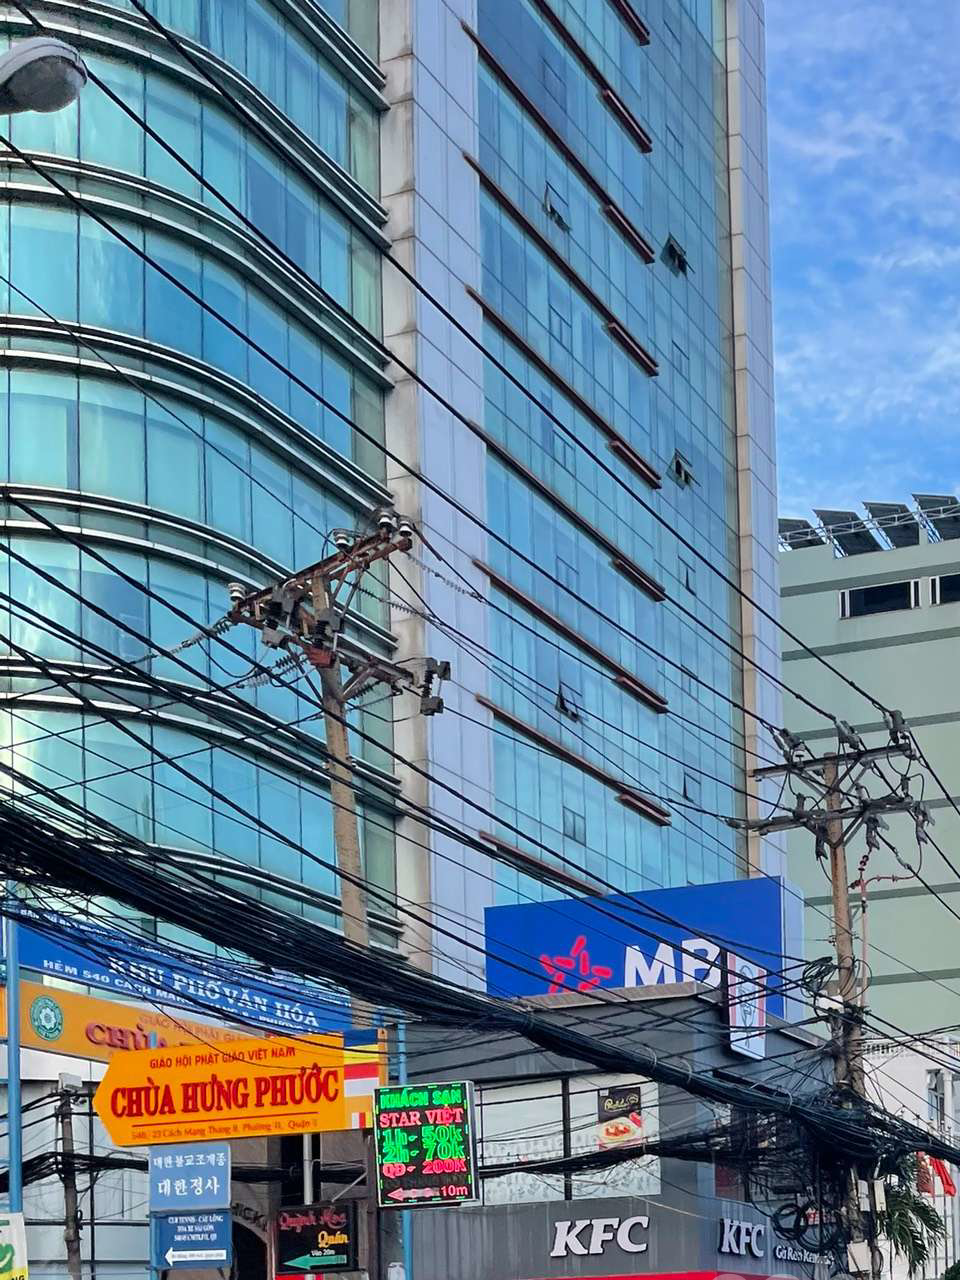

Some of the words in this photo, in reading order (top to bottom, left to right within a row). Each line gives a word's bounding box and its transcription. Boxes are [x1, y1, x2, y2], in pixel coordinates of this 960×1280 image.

[623, 937, 721, 989] MB
[82, 968, 111, 984] 540
[271, 1046, 296, 1058] NAM
[110, 1075, 177, 1118] CHÙA
[180, 1073, 250, 1114] HƯNG
[254, 1062, 339, 1108] PHƯỚC
[380, 1111, 422, 1128] STAR
[425, 1105, 464, 1126] VIỆT
[421, 1125, 463, 1143] 50k
[423, 1141, 466, 1161] 70k
[157, 1175, 221, 1197] 대한정사
[440, 1185, 469, 1197] 10m
[317, 1230, 349, 1248] Quán
[550, 1215, 650, 1258] KFC
[720, 1218, 765, 1258] KFC
